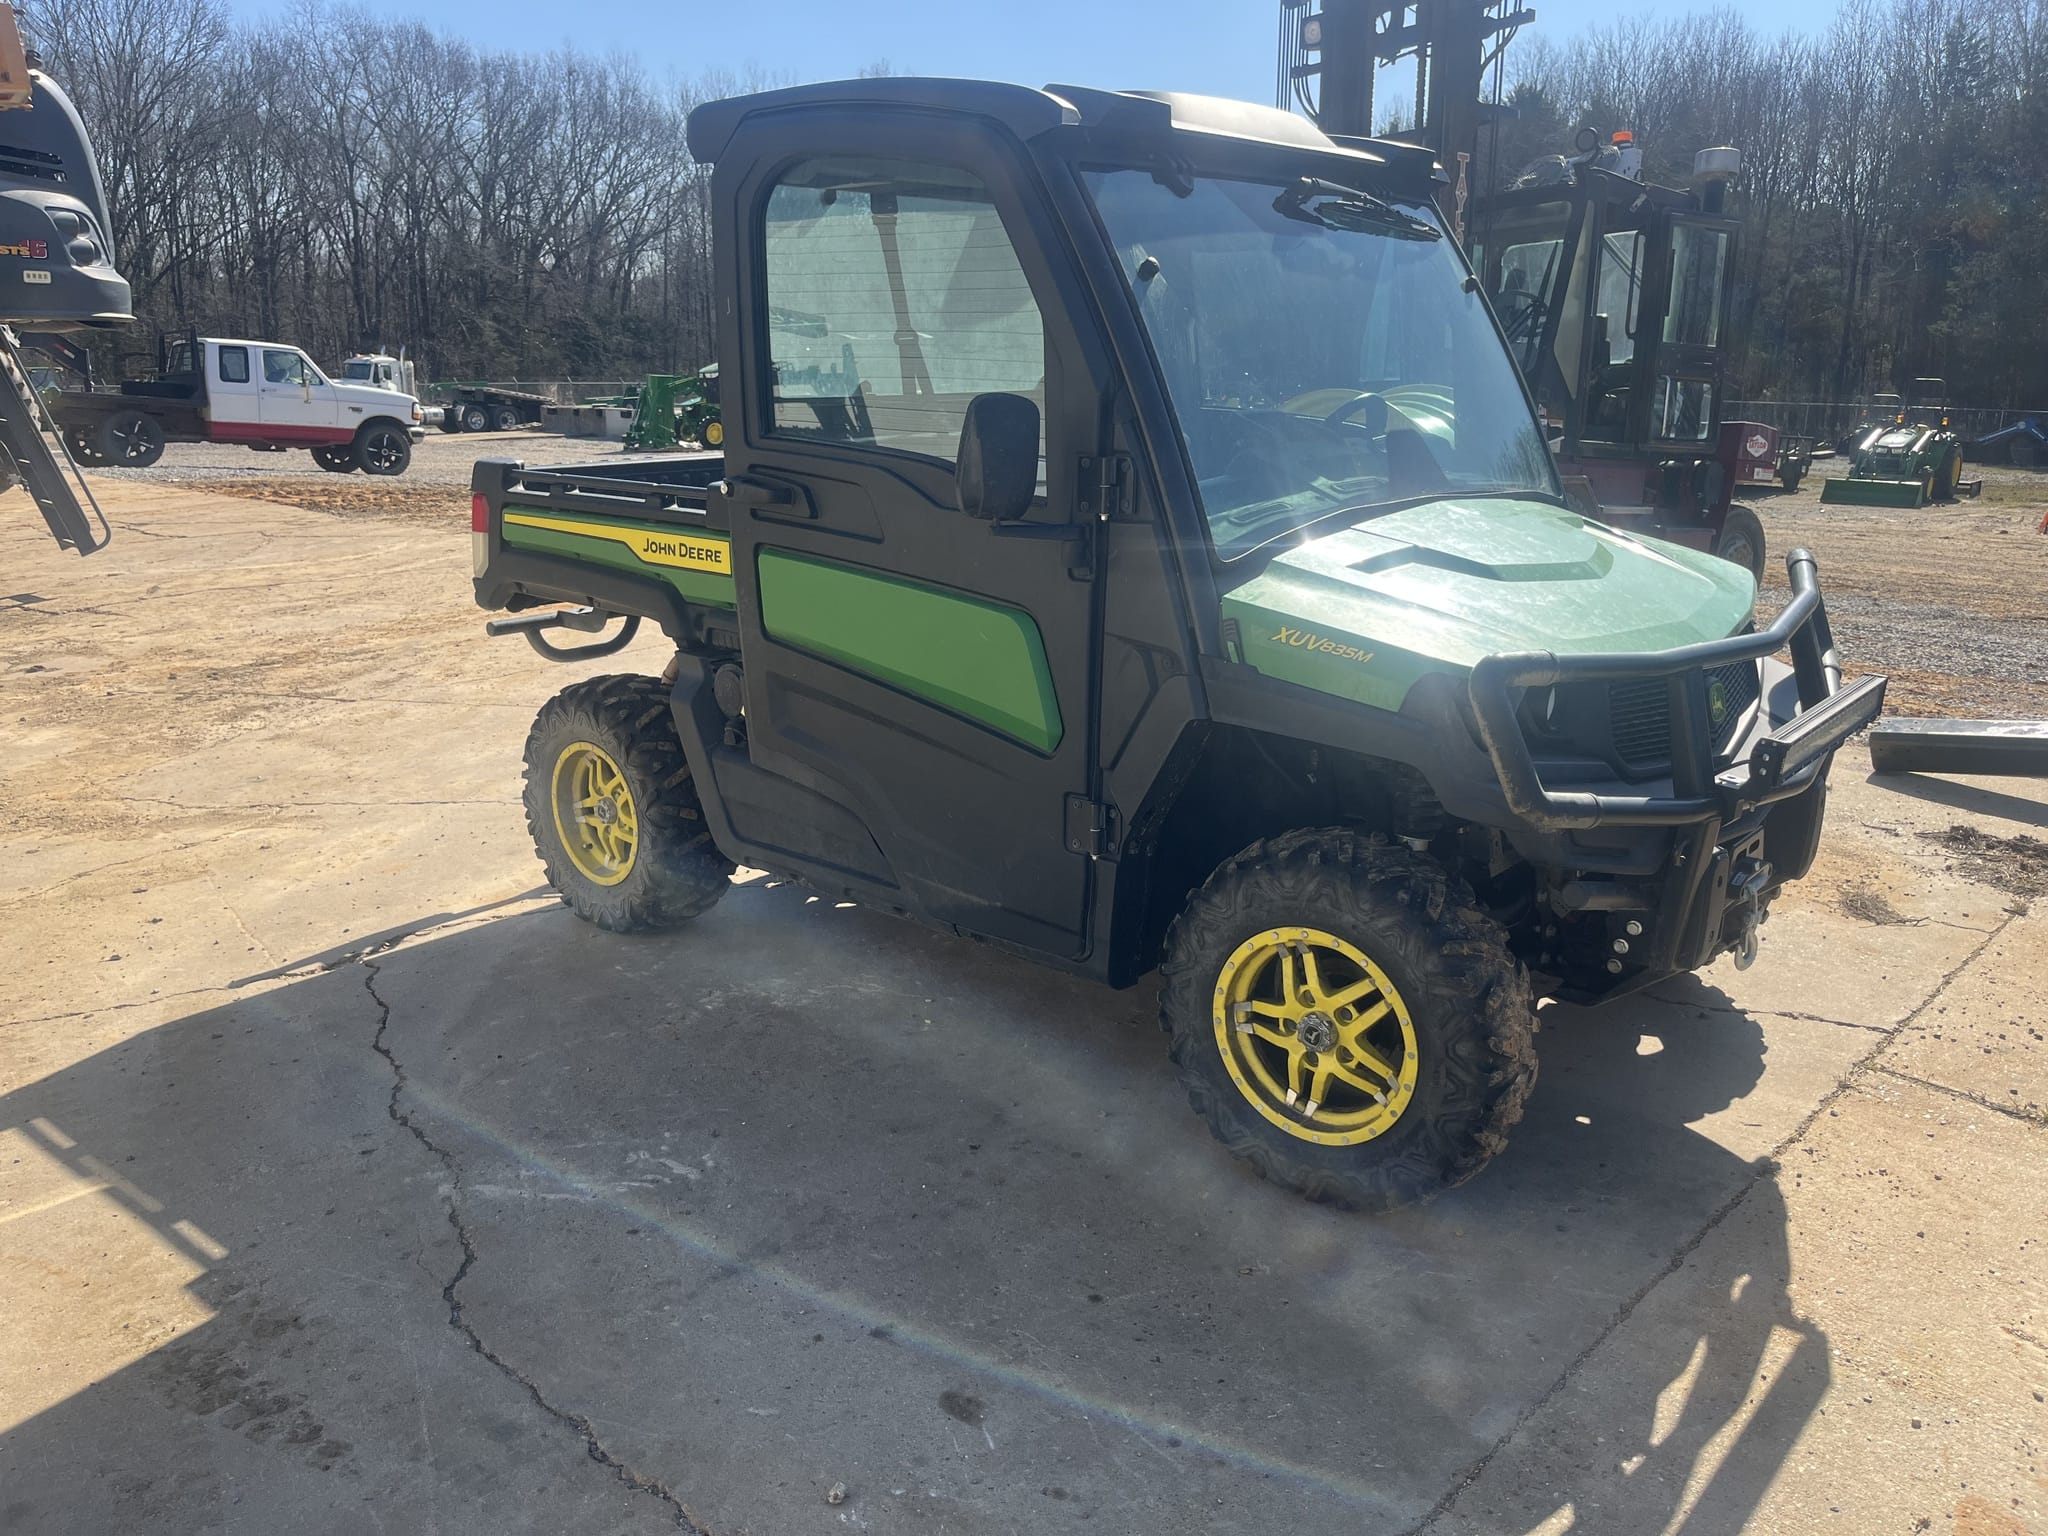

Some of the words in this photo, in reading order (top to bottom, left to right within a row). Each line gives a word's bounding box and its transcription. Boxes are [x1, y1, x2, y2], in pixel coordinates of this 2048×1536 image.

[643, 538, 676, 556] JOHN
[679, 543, 722, 563] DEERE
[1270, 626, 1375, 663] XUV835M
